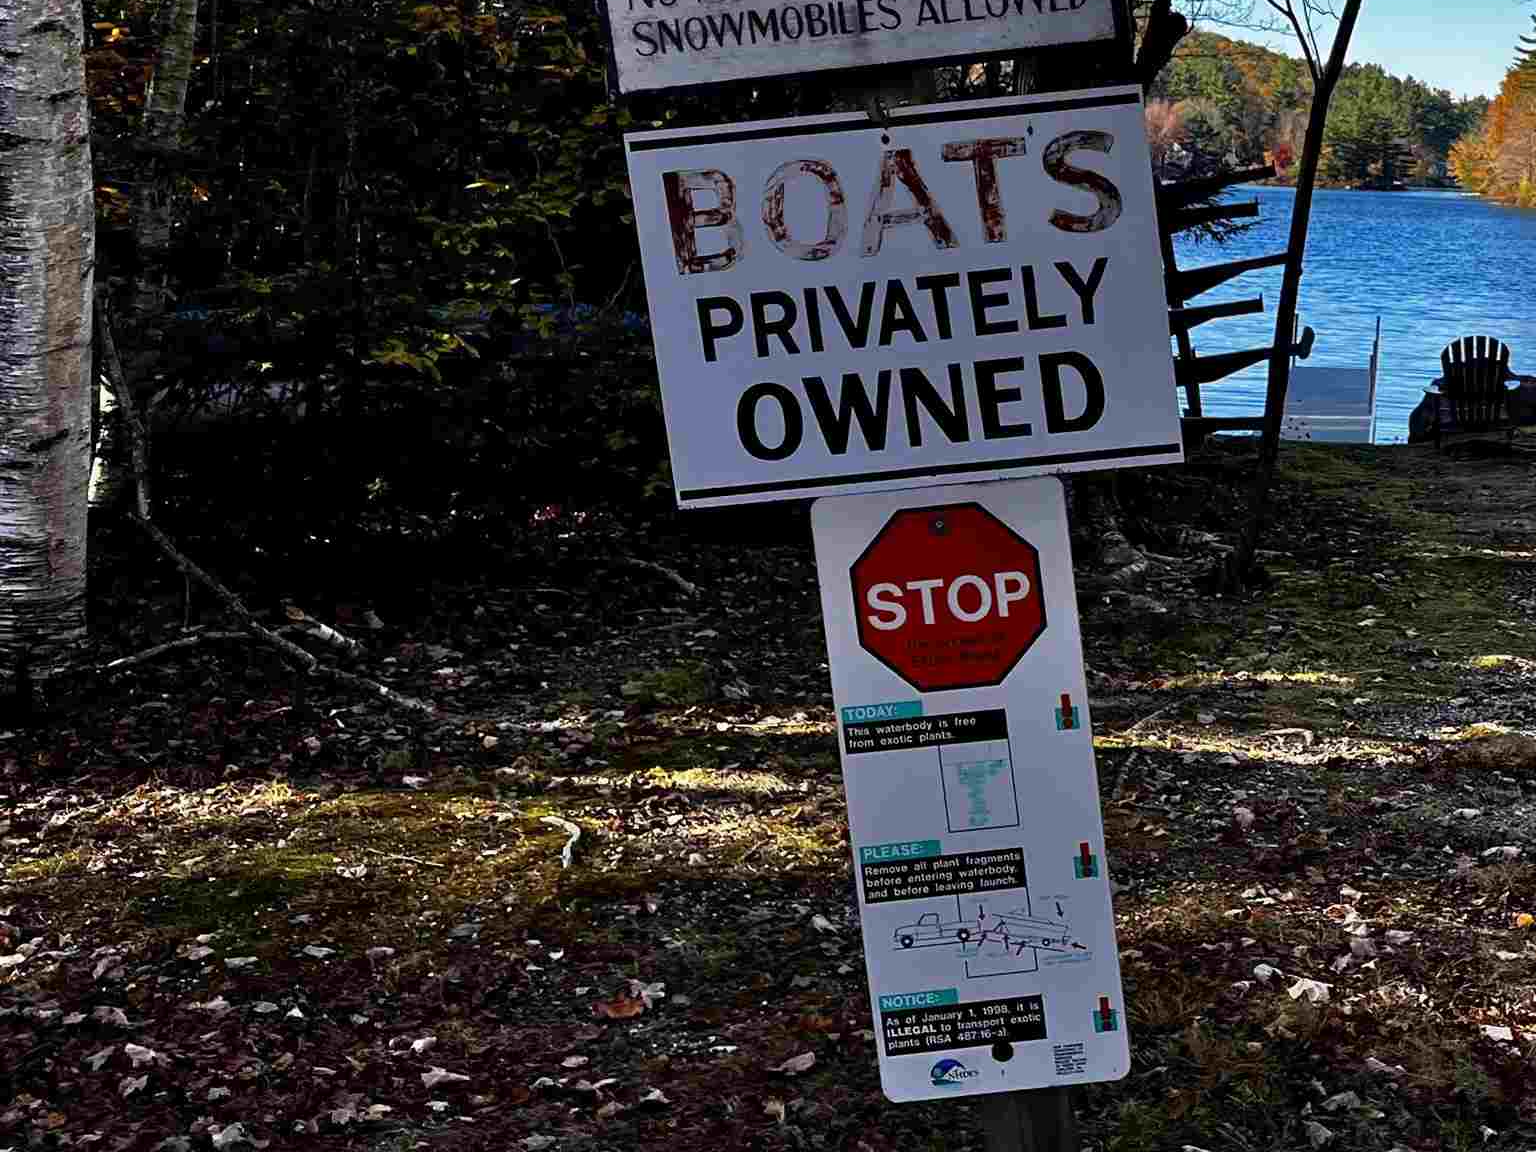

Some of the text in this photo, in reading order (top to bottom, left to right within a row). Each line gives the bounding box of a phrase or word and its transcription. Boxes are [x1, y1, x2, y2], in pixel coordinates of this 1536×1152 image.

[662, 129, 1124, 276] BOATS
[696, 257, 1109, 363] PRIVATELY
[736, 351, 1106, 462] OWNED
[866, 571, 1031, 631] STOP
[847, 717, 977, 737] This waterbody is free
[849, 739, 874, 749] from
[880, 735, 913, 745] exotic
[864, 865, 908, 876] Remove
[933, 858, 960, 870] plant
[966, 852, 1021, 866] fragments
[866, 878, 902, 888] before
[907, 870, 953, 882] entering
[867, 888, 888, 899] and
[894, 885, 929, 896] before
[935, 880, 974, 893] leaving
[886, 1018, 899, 1027] As
[905, 1015, 916, 1025] of
[921, 1011, 963, 1023] January
[1016, 1001, 1024, 1011] it
[1029, 1001, 1039, 1010] is
[886, 1014, 1041, 1037] ILLEGAL to transport exotic
[888, 1039, 920, 1050] plants
